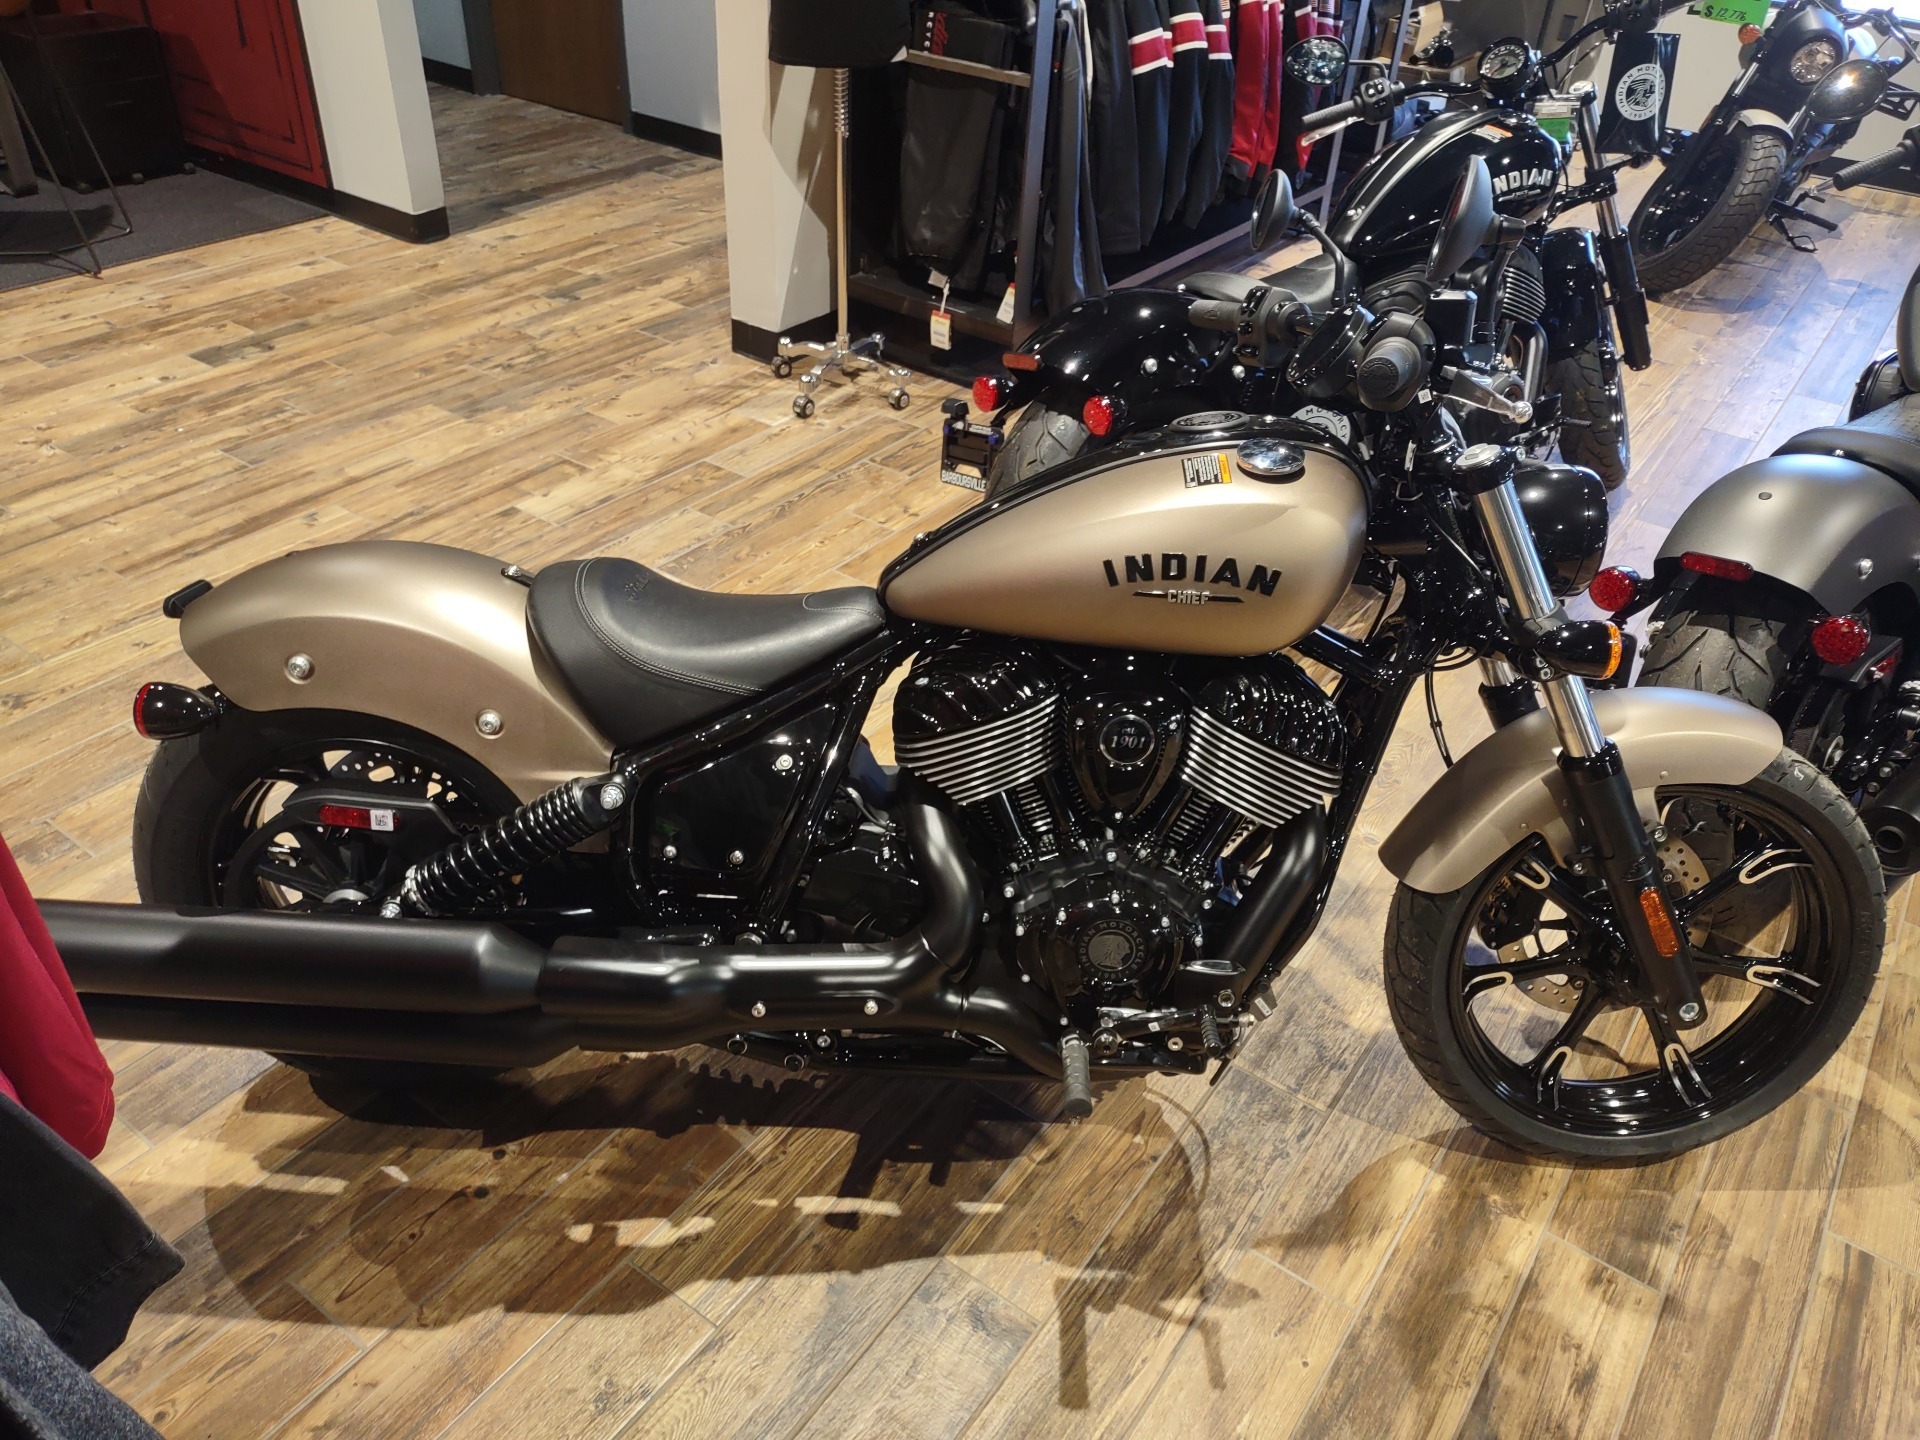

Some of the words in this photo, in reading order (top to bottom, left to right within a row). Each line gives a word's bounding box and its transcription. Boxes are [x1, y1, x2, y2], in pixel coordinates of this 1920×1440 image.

[1704, 4, 1714, 17] $
[1618, 73, 1633, 108] INDIAN
[1492, 168, 1553, 195] NDIAN
[1102, 552, 1283, 597] INDIAN
[1167, 589, 1211, 605] CHIEF
[1111, 735, 1146, 749] 1901
[1080, 928, 1097, 967] INDIAN
[1099, 921, 1145, 970] MOTORCYCLE
